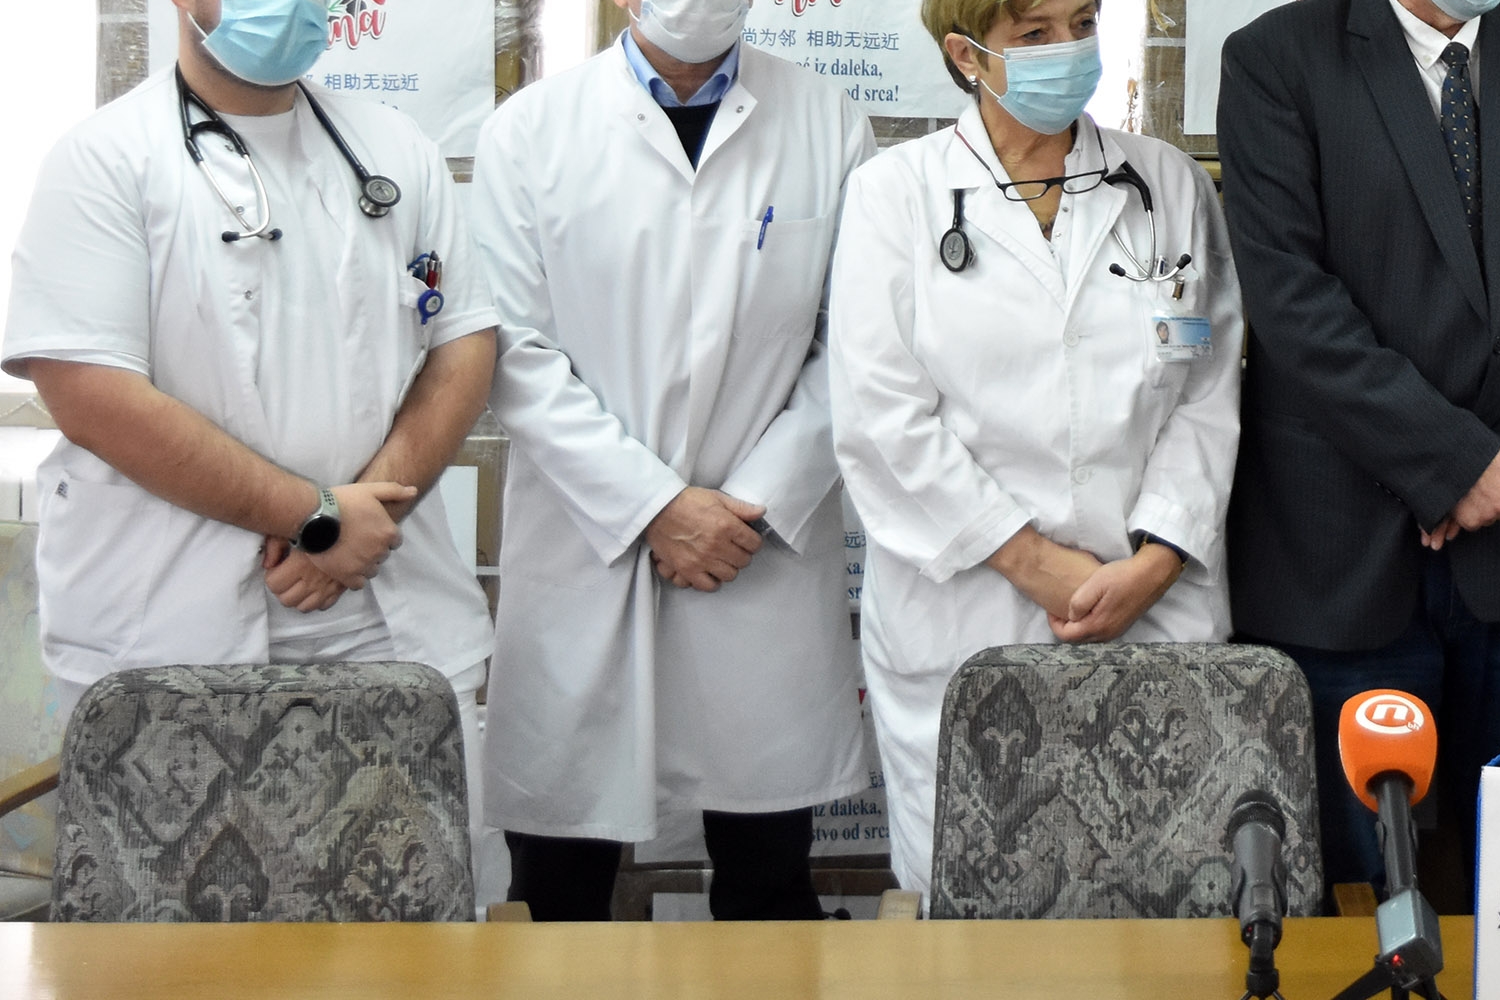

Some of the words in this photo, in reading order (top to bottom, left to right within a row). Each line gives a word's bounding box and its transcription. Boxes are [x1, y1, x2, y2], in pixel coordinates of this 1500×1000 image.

[814, 56, 827, 75] iz
[831, 57, 882, 80] daleka,
[863, 84, 899, 102] srca!
[830, 799, 882, 817] daleka,
[842, 823, 860, 841] od
